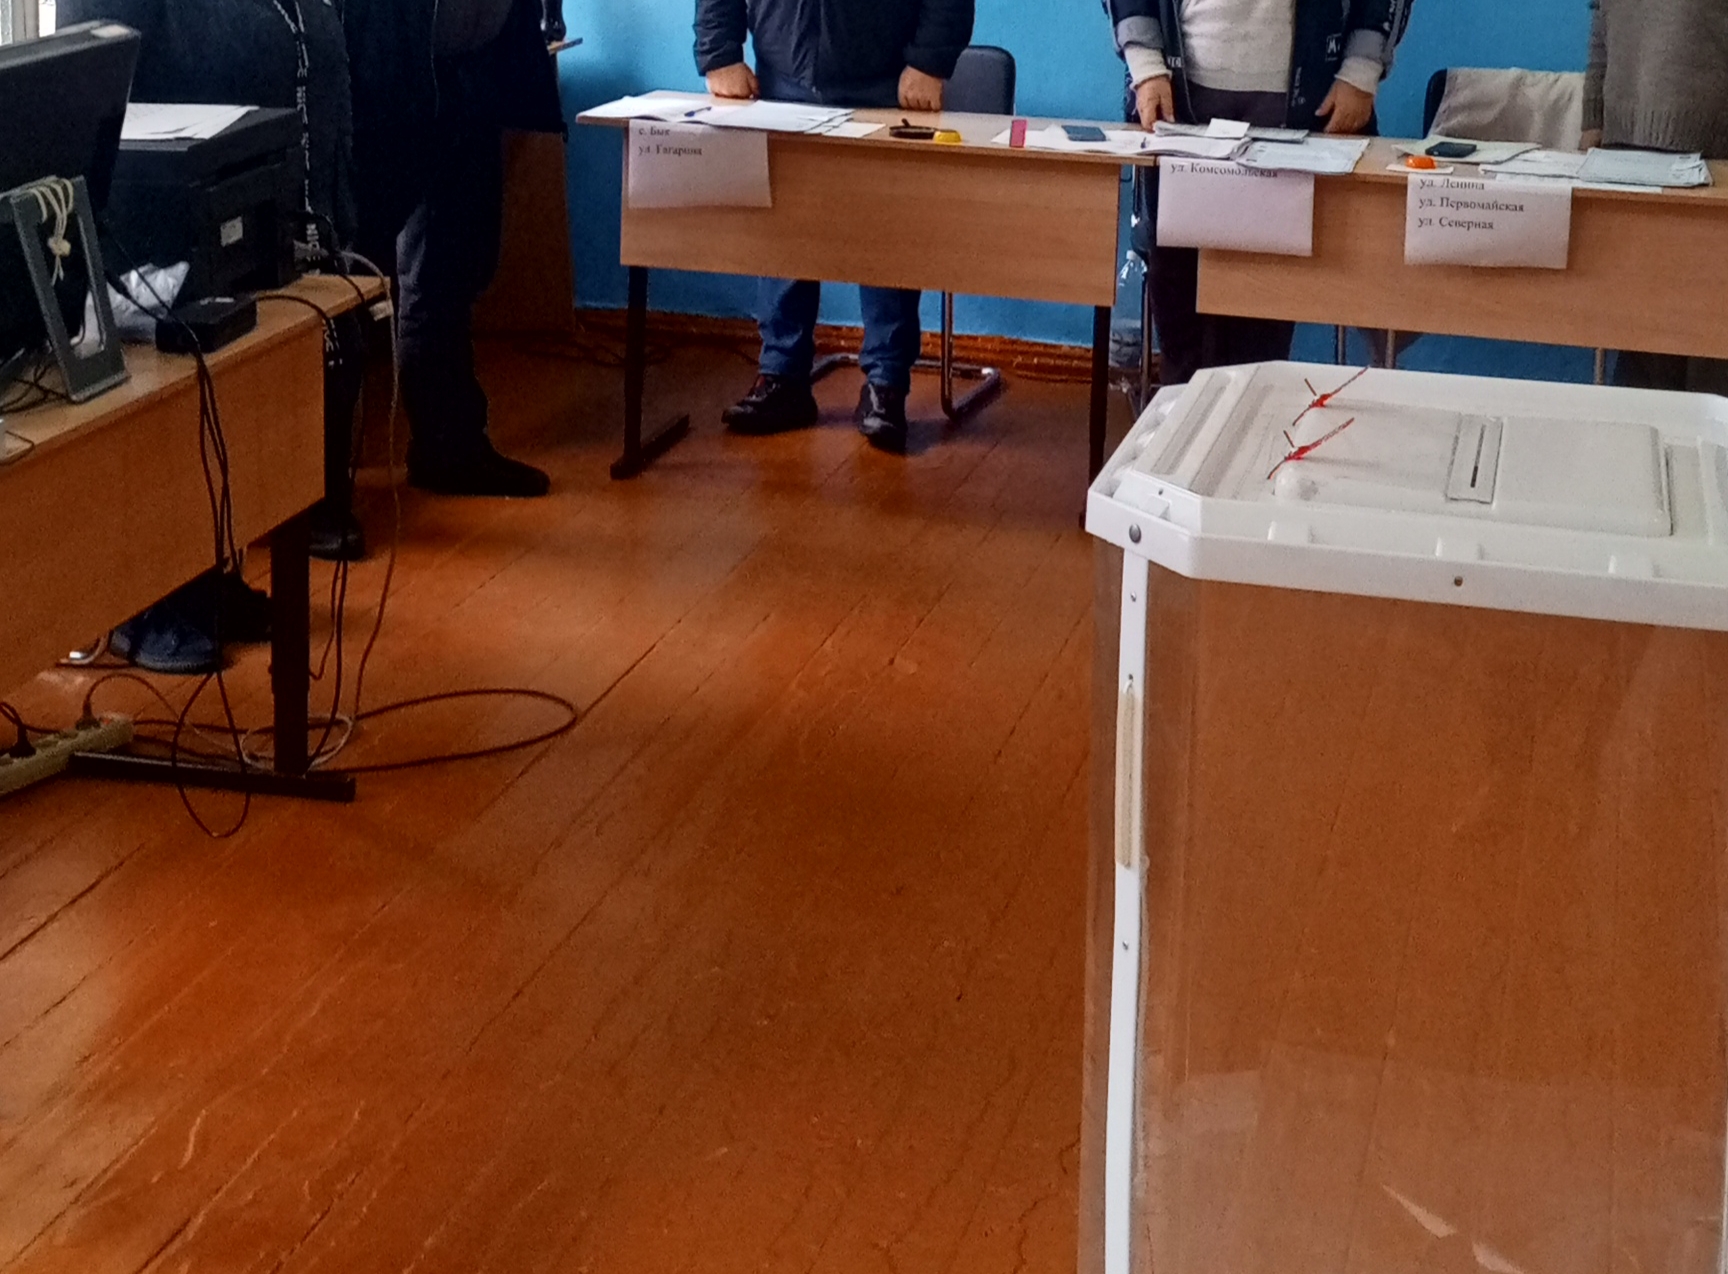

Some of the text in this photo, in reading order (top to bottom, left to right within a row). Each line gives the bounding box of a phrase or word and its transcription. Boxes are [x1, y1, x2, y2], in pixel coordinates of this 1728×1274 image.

[1190, 162, 1278, 178] Комсомольская
[1440, 177, 1485, 190] Ленина
[1418, 196, 1525, 213] ул. Первомайская
[1438, 216, 1494, 231] Северная
